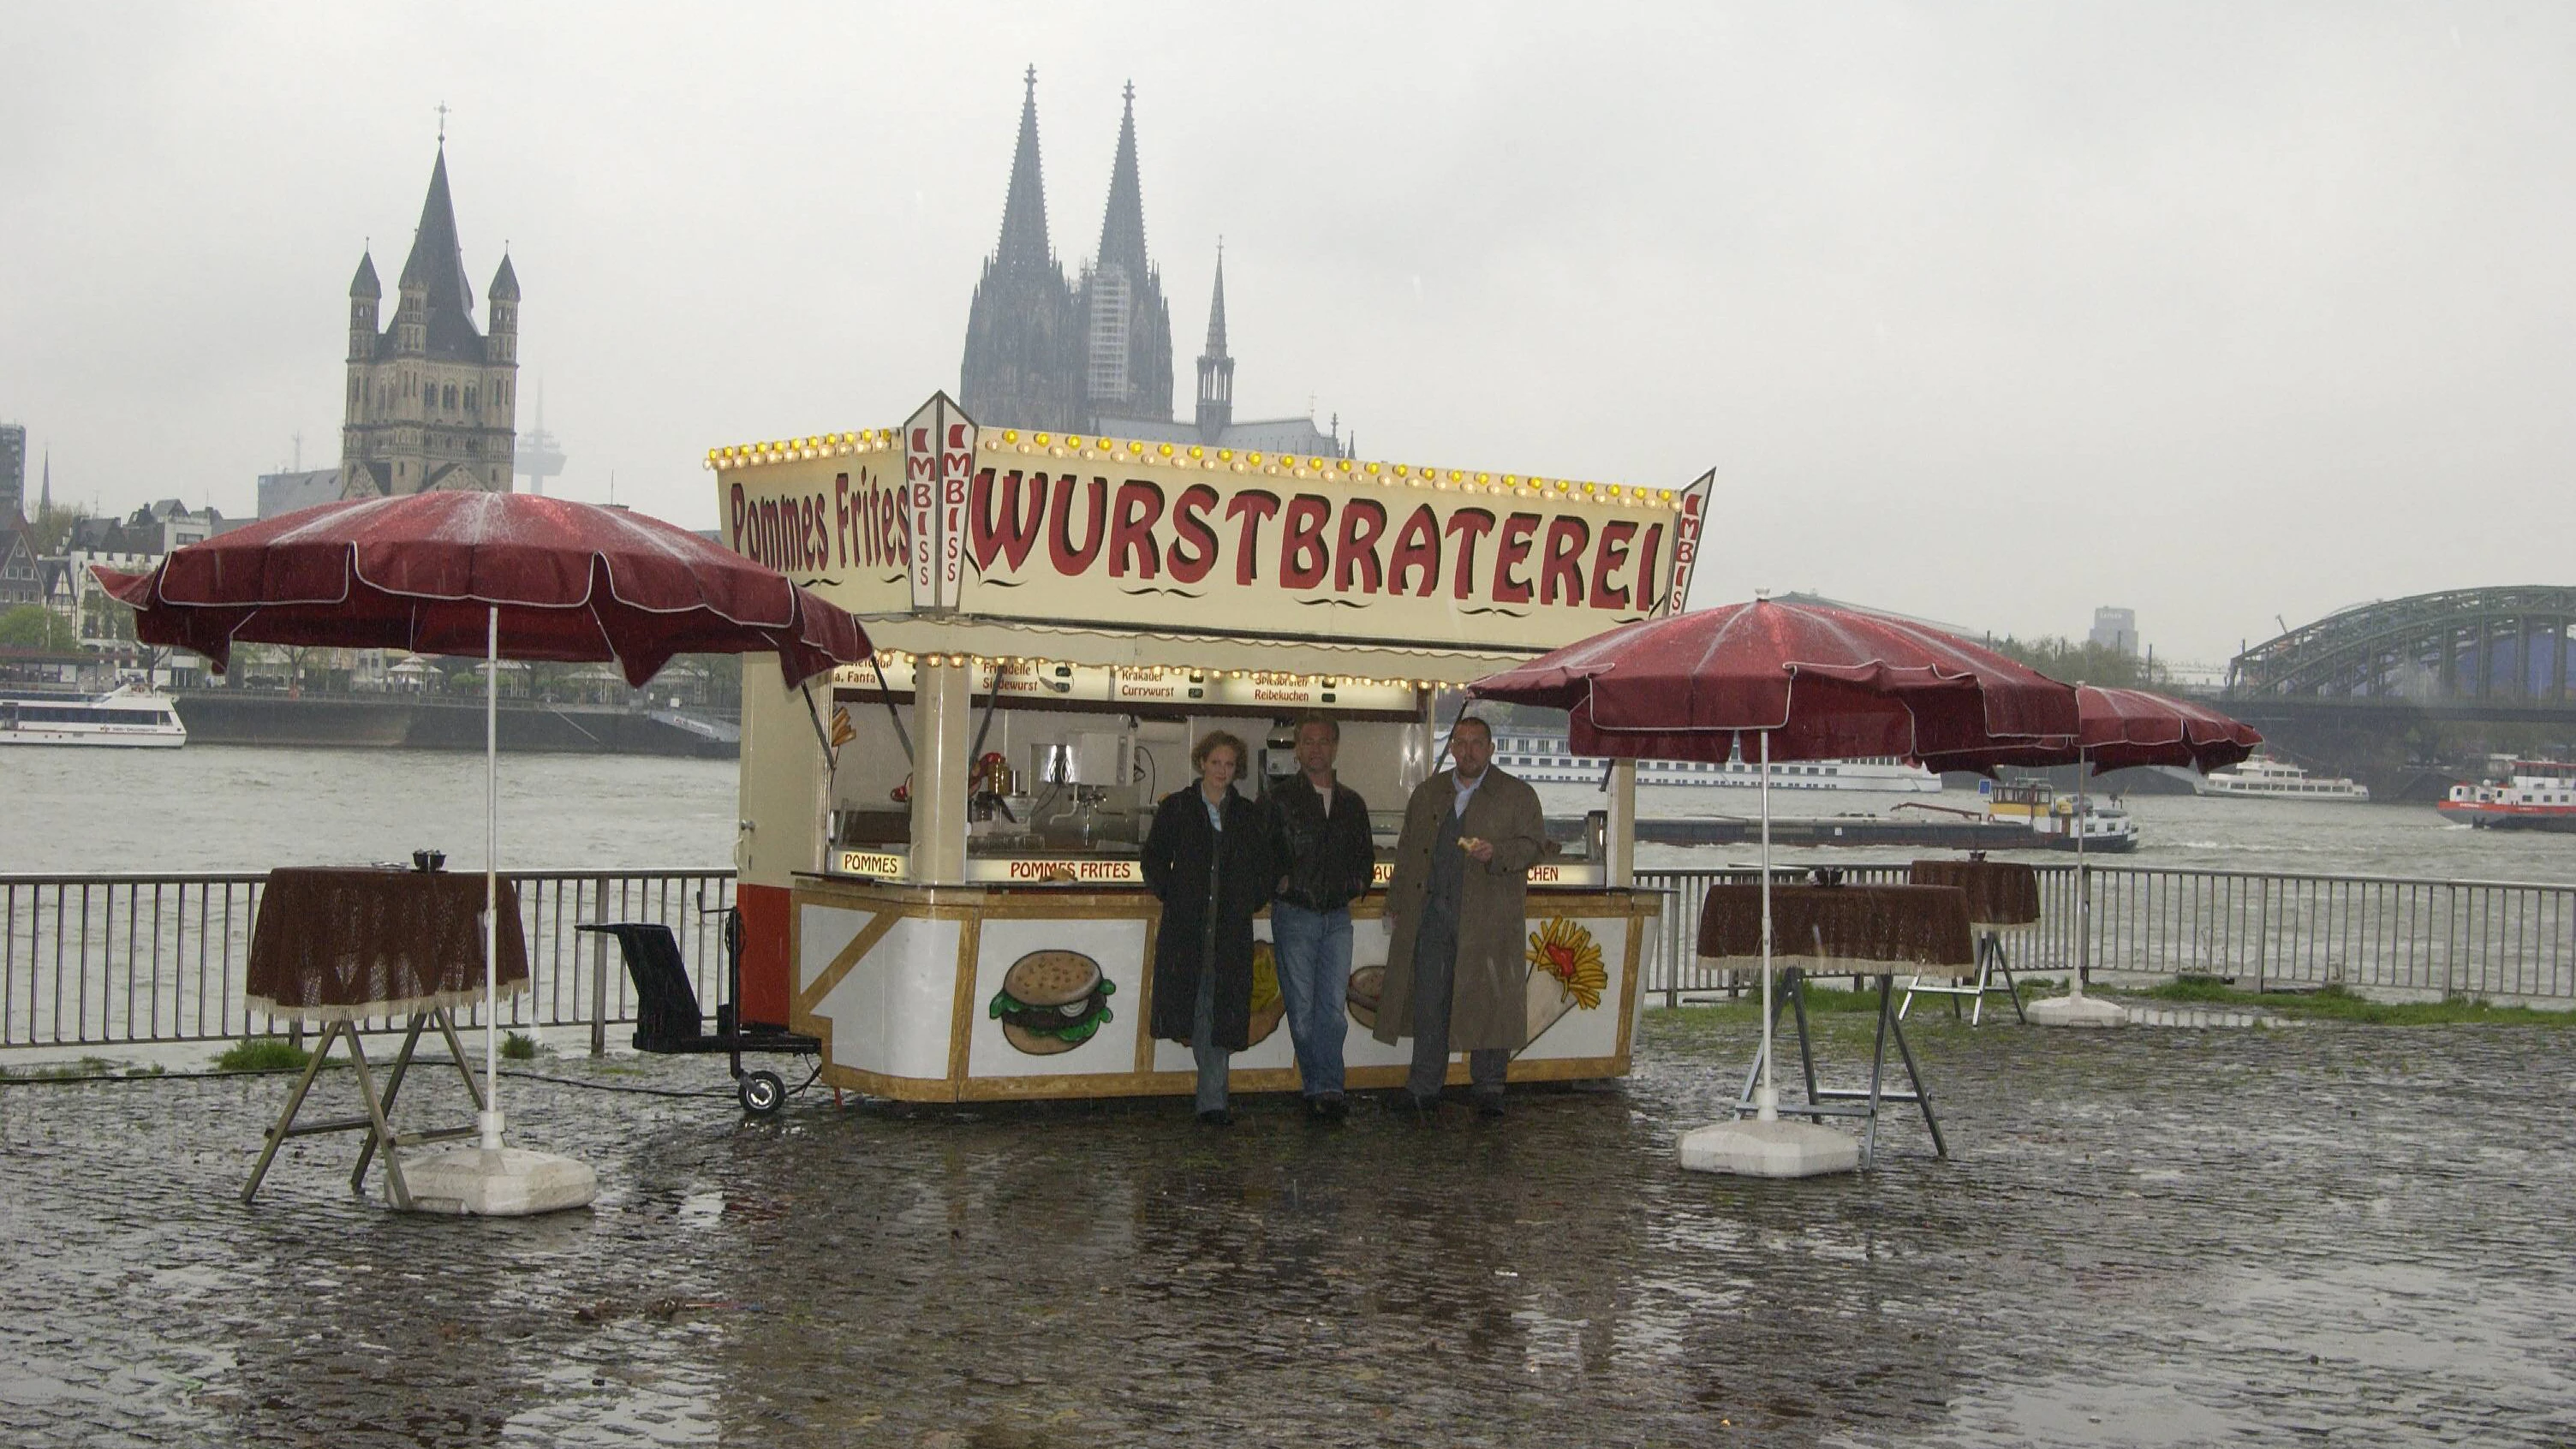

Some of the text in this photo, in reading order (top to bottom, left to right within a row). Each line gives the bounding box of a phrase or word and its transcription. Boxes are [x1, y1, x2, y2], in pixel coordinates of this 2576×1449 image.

[908, 427, 936, 586] IMBISS
[944, 424, 972, 581] IMBISS
[731, 465, 911, 572] Pommes Frites
[969, 467, 1663, 611] WURSTBRATEREI
[1673, 493, 1702, 615] IMBIS
[848, 671, 876, 683] Fanta
[982, 662, 1031, 676] Friadelle
[982, 677, 1038, 692] Sidewurst
[1122, 685, 1175, 697] Currywurst
[1255, 689, 1309, 702] Reibekuchen
[844, 854, 897, 874] POMMES
[1081, 862, 1130, 879] FRITES
